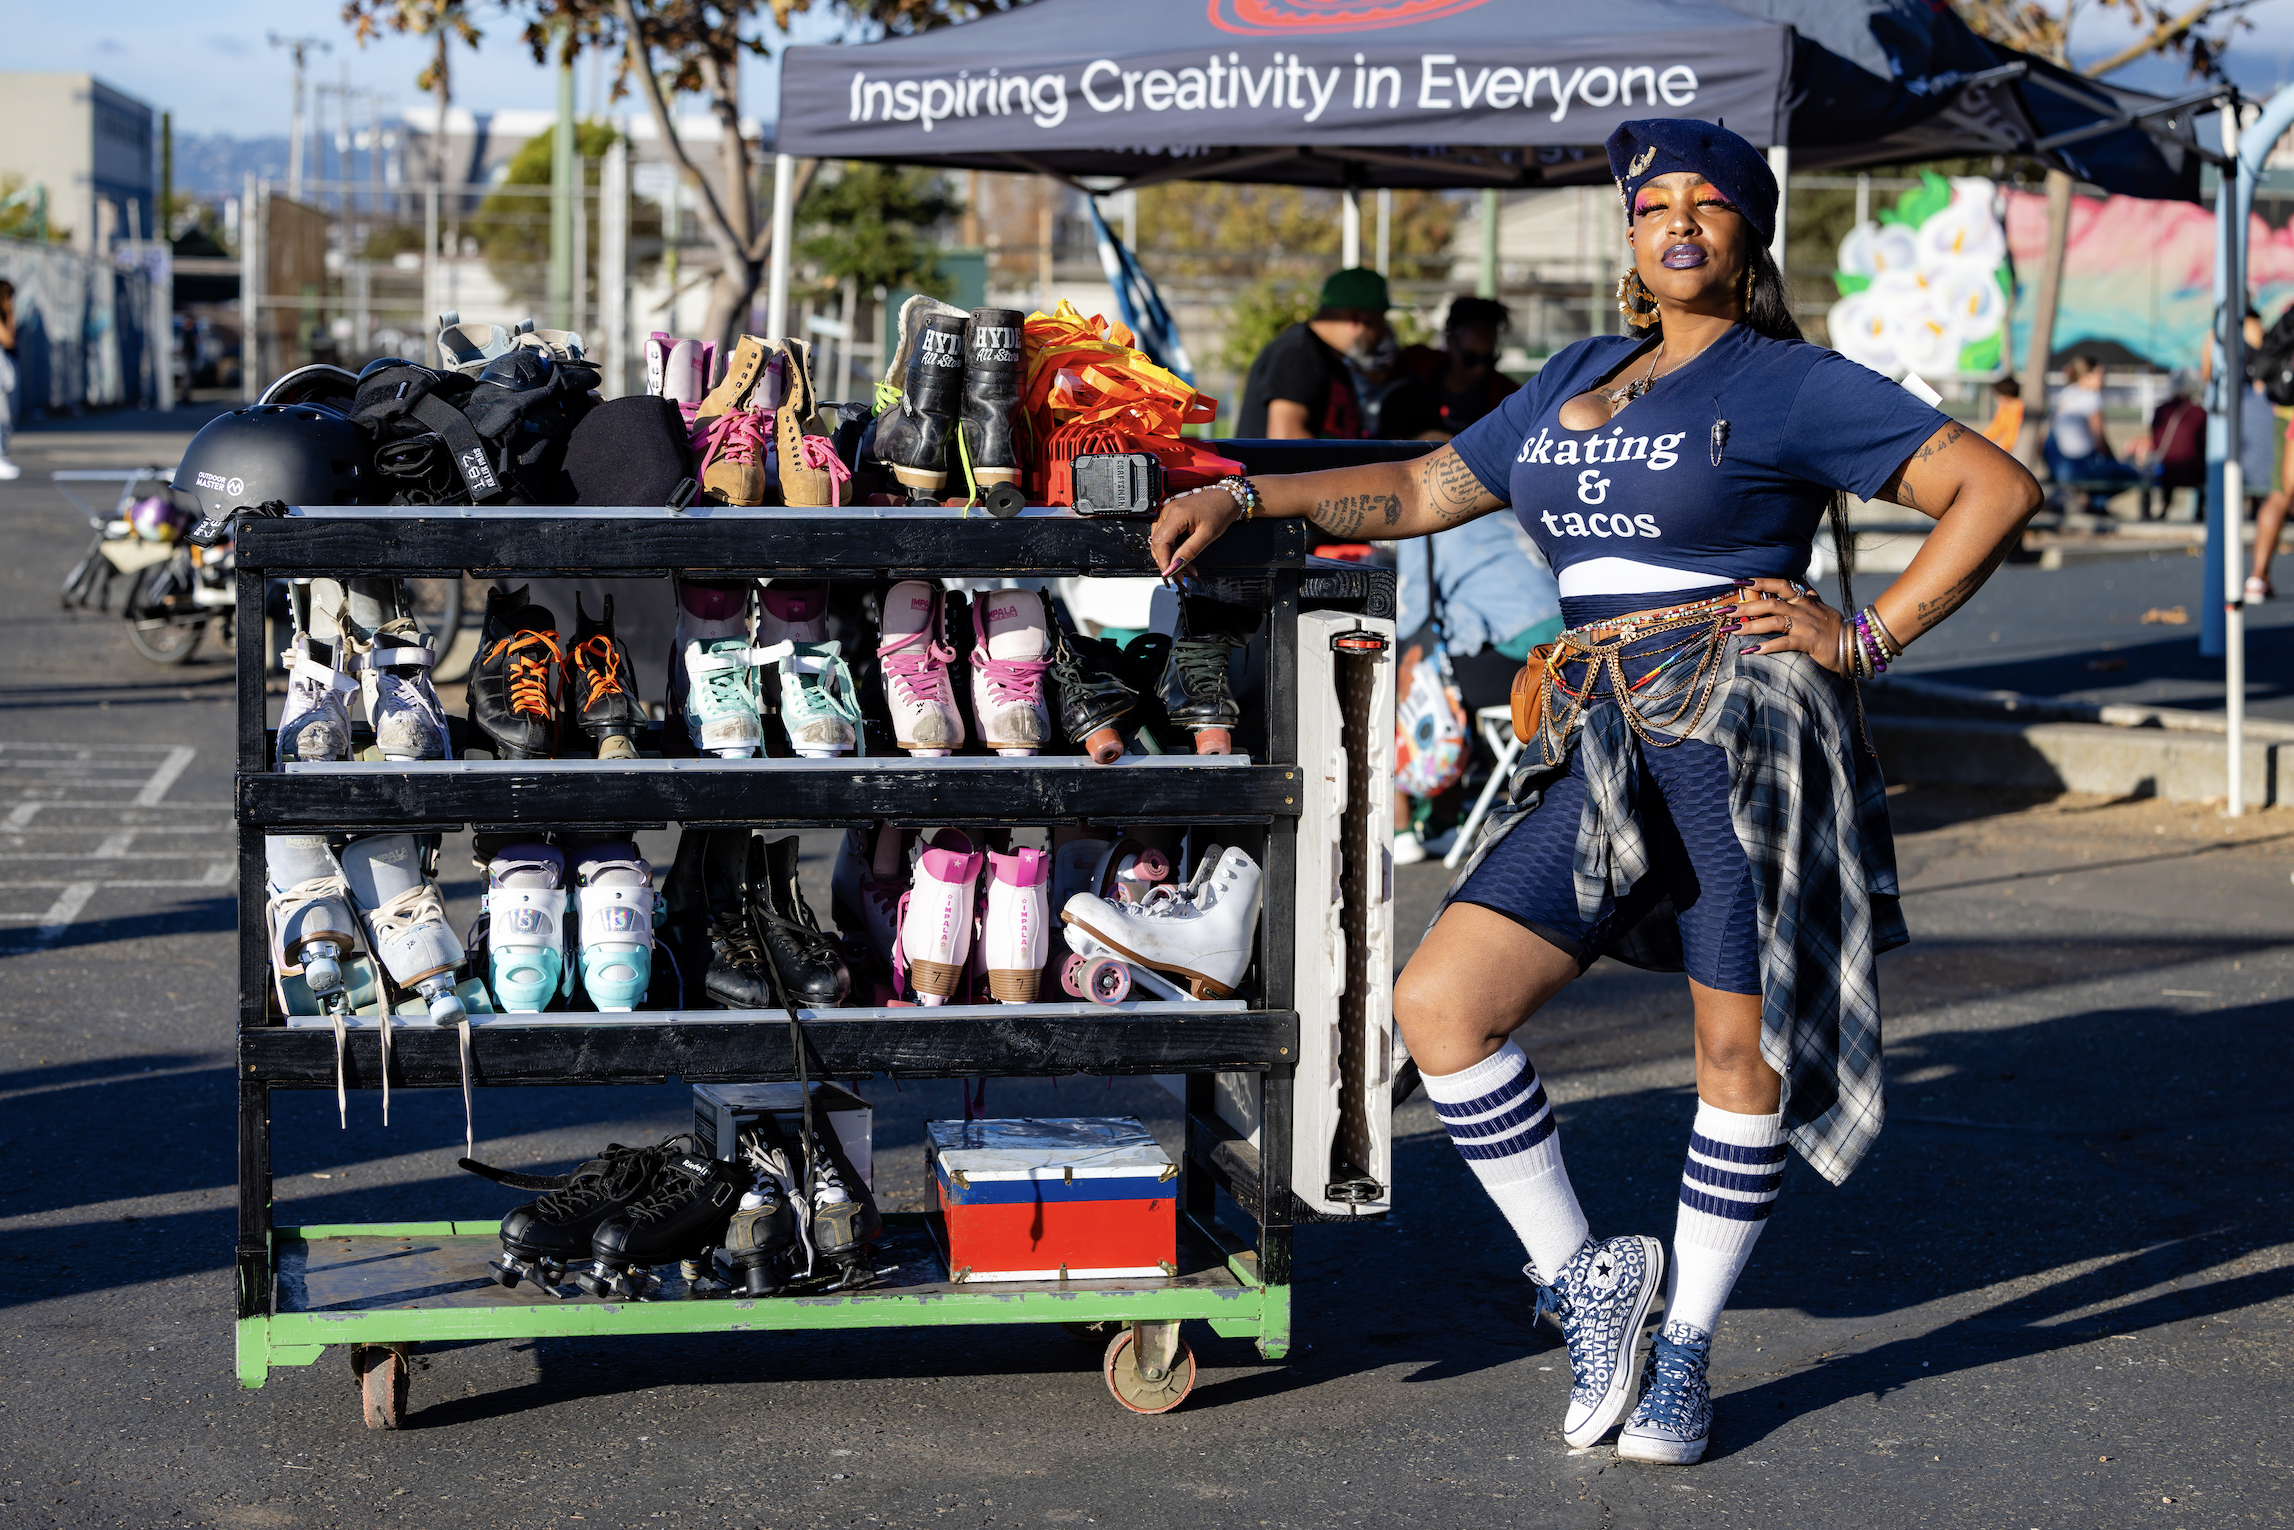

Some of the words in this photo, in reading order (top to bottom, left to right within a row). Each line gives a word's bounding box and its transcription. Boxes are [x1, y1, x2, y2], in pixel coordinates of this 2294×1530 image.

[849, 68, 1068, 132] Inspiring
[1080, 52, 1342, 121] Creativity
[1352, 53, 1401, 109] in
[1417, 54, 1698, 123] Everyone
[976, 326, 1021, 349] HYDE
[921, 351, 938, 366] All
[976, 348, 994, 362] All
[1517, 426, 1686, 471] skating
[1937, 440, 1947, 452] is
[473, 448, 487, 466] PADS
[198, 471, 227, 484] OUTDOOR
[462, 455, 486, 489] 187
[480, 465, 496, 487] KILLER
[195, 478, 225, 492] MASTER
[1116, 460, 1127, 509] CRAFTSMAN
[1578, 469, 1611, 505] &
[1360, 494, 1370, 511] God
[1540, 509, 1662, 539] tacos
[911, 598, 931, 607] IMPA
[988, 606, 1018, 619] MPALA
[370, 847, 407, 863] MPALA
[941, 900, 952, 941] IMPALA
[1021, 904, 1029, 946] IMPALA
[933, 971, 942, 984] 7
[1016, 978, 1024, 991] 7
[682, 1159, 709, 1176] Riedell
[1594, 1299, 1614, 1395] CONVERSE
